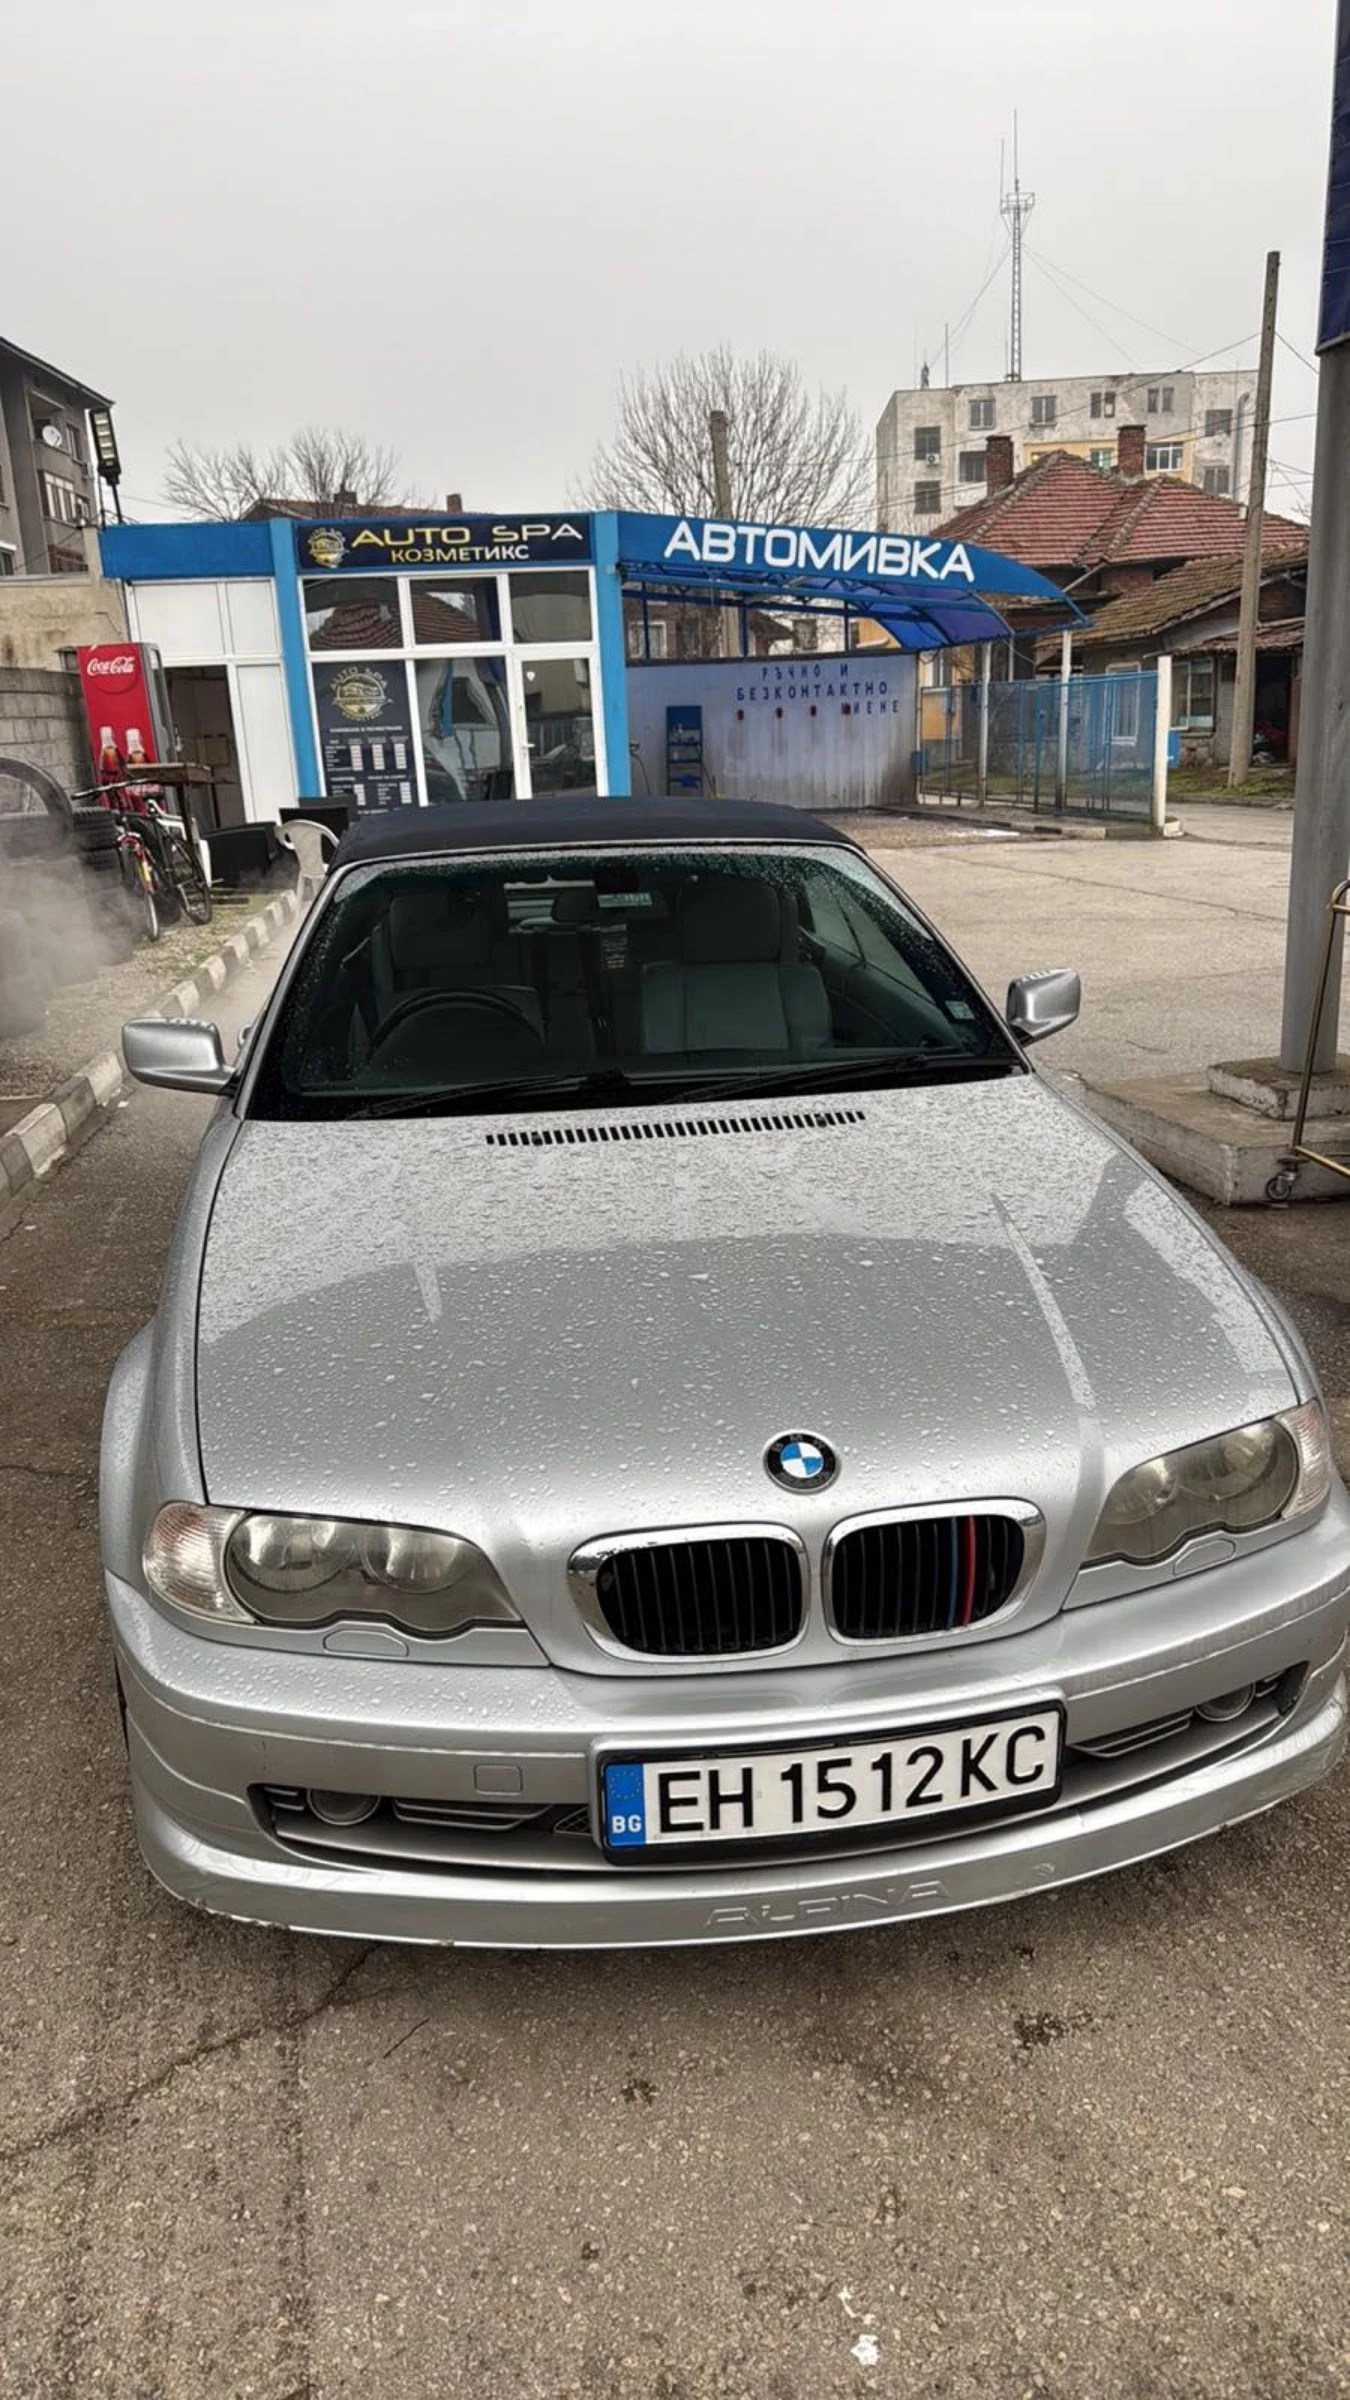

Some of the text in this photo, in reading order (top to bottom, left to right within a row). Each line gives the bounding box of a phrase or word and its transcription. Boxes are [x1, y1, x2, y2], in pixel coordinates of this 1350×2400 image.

[351, 527, 471, 548] AUTO
[491, 523, 584, 543] SPA
[391, 545, 530, 563] КОЗМЕТИКС
[663, 520, 976, 583] АВТОМИВКА
[762, 663, 821, 681] РЪЧНО
[736, 681, 888, 701] БЕЗКОНТАКТНО
[657, 1724, 1046, 1834] EH 1512 KC
[612, 1814, 642, 1834] BG
[704, 1879, 951, 1928] ALPINA
